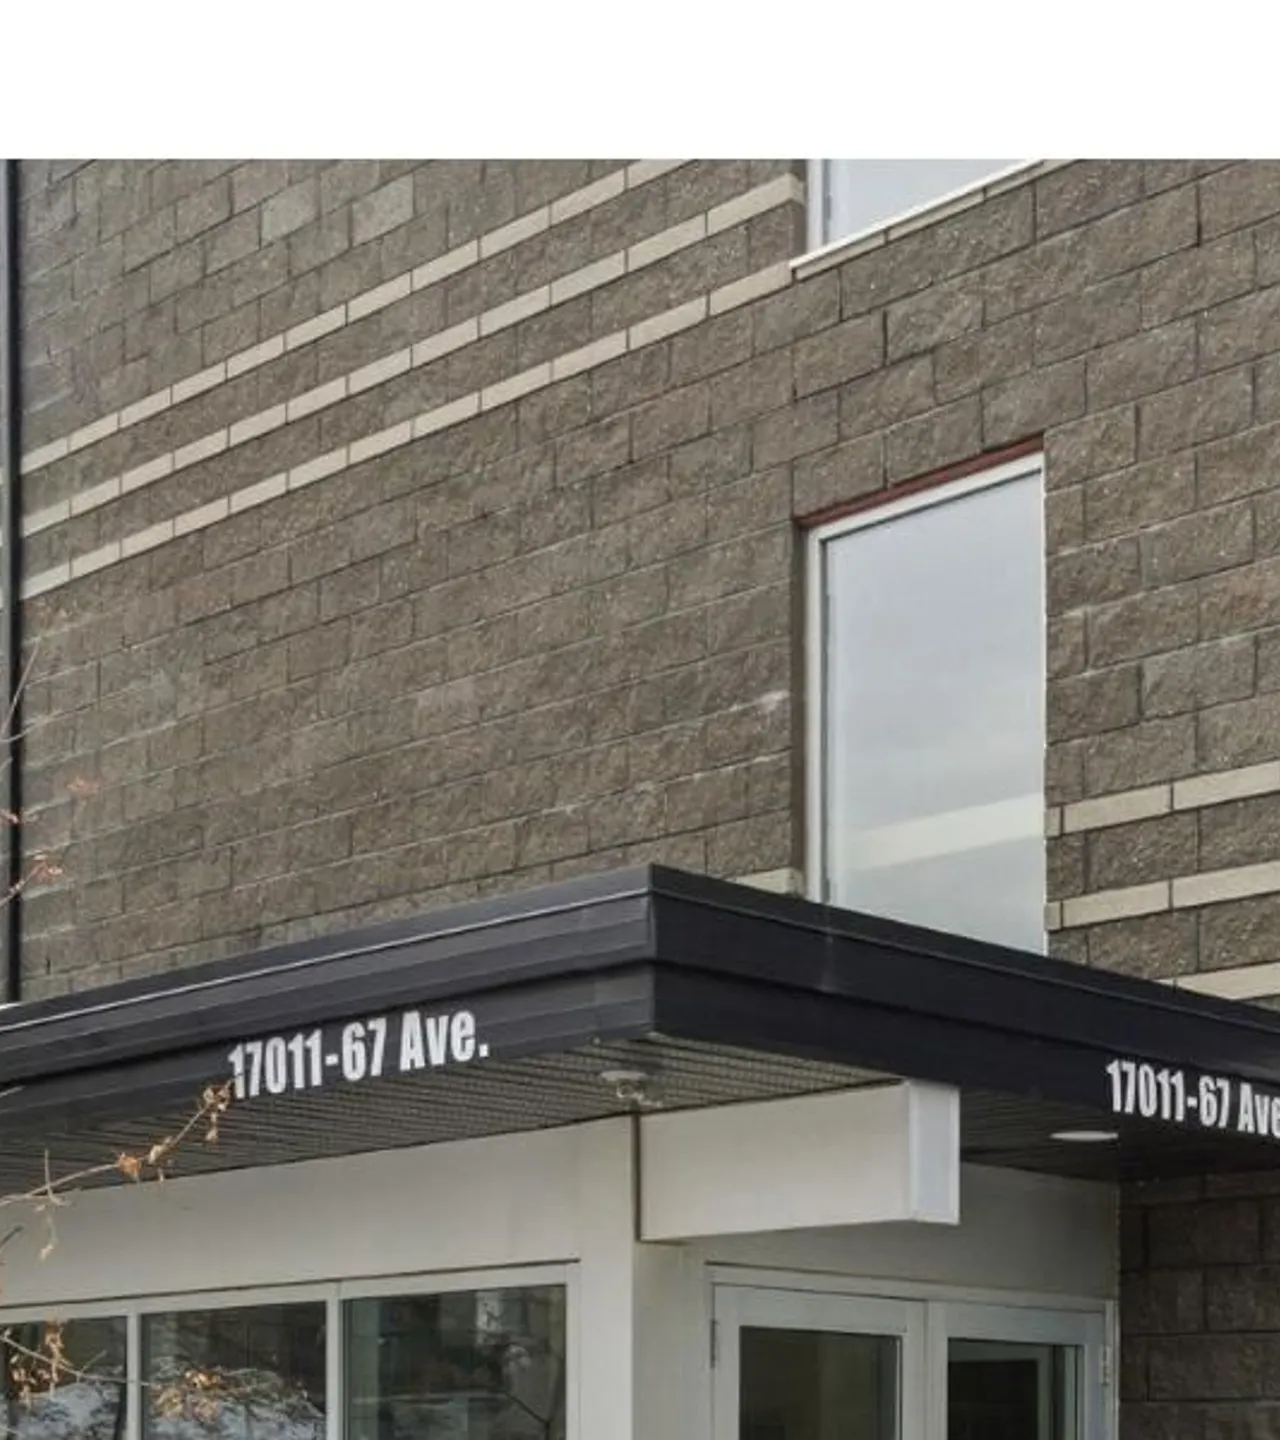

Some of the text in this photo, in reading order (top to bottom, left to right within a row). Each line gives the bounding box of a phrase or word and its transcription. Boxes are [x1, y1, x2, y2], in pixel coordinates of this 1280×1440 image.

[228, 1009, 489, 1099] 17011-67 Ave.
[1105, 1059, 1230, 1129] 17011-67
